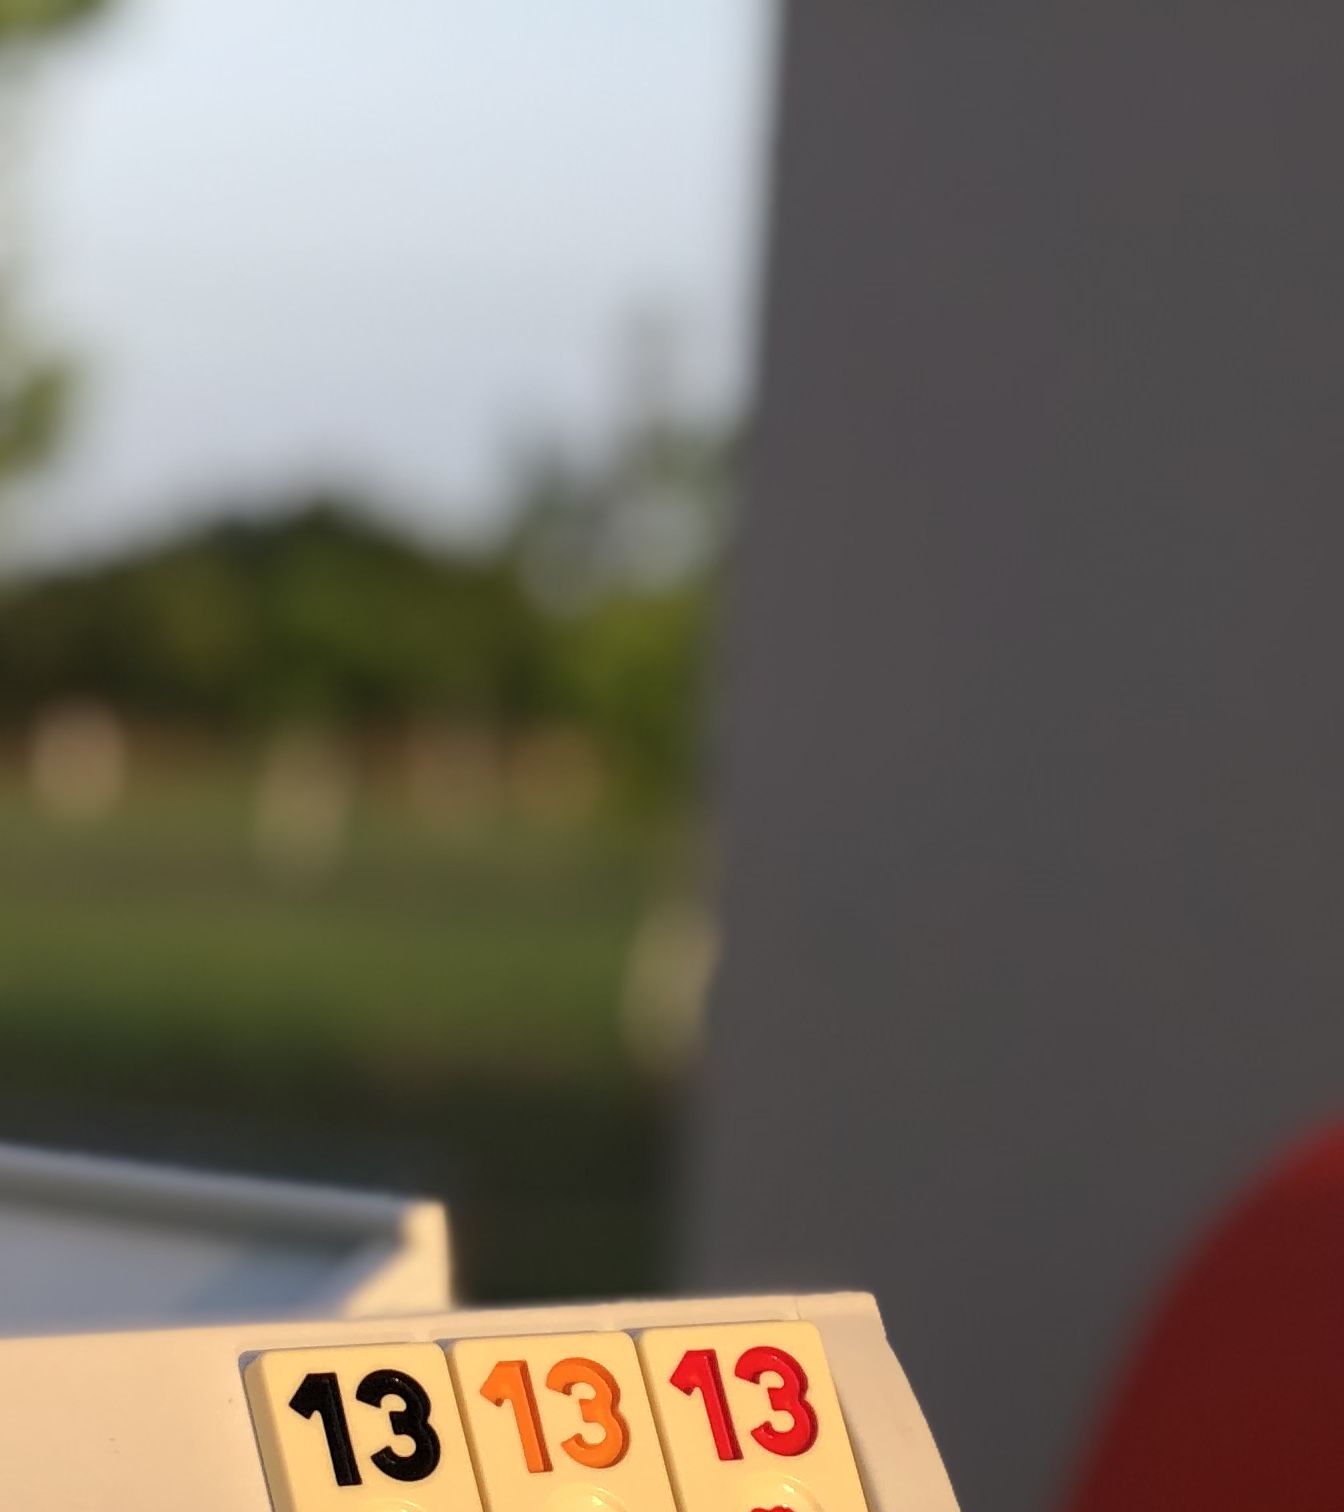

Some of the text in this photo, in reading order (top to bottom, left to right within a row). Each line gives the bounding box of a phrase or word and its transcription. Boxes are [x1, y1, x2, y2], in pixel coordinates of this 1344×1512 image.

[288, 1369, 441, 1487] 13
[479, 1357, 630, 1474] 13
[670, 1346, 819, 1462] 13
